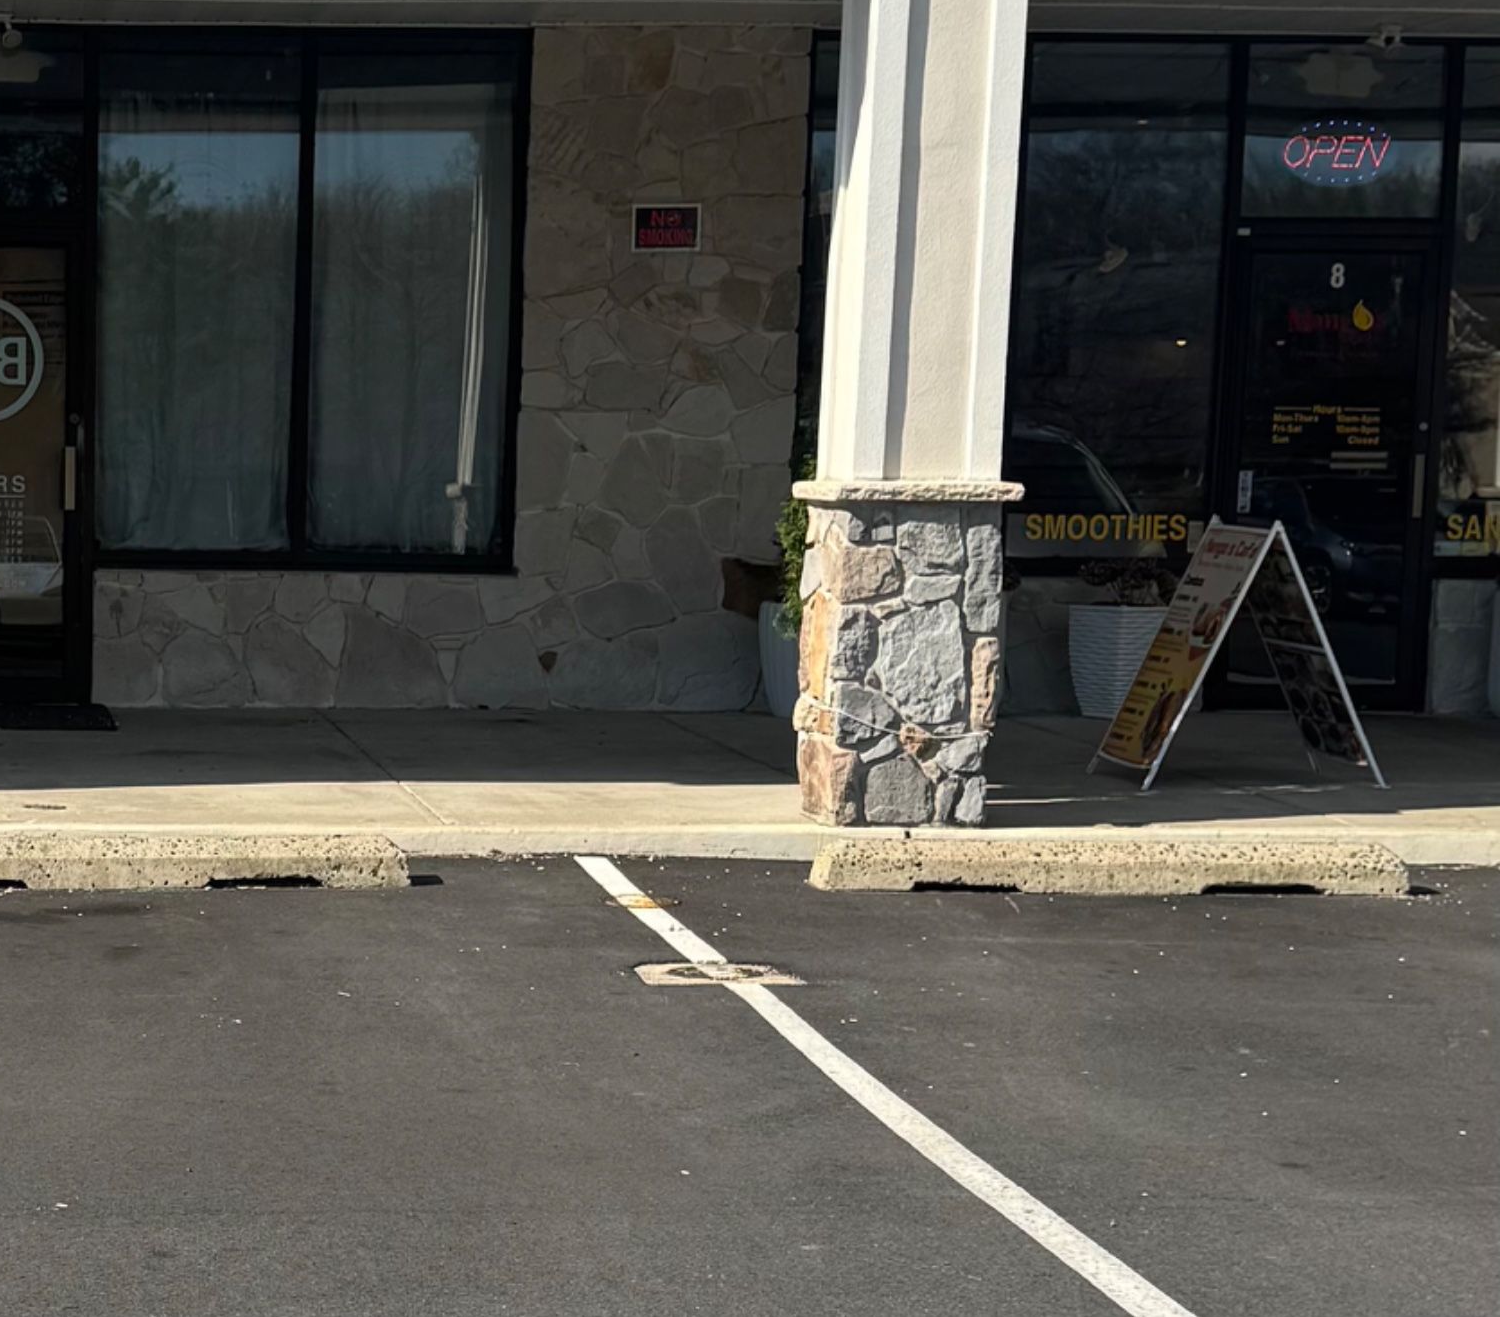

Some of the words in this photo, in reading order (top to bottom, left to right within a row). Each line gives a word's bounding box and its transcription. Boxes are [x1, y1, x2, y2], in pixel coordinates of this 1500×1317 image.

[1284, 135, 1391, 170] OPEN
[649, 210, 683, 227] NO
[1330, 262, 1345, 289] 8
[1025, 513, 1189, 542] SMOOTHIES
